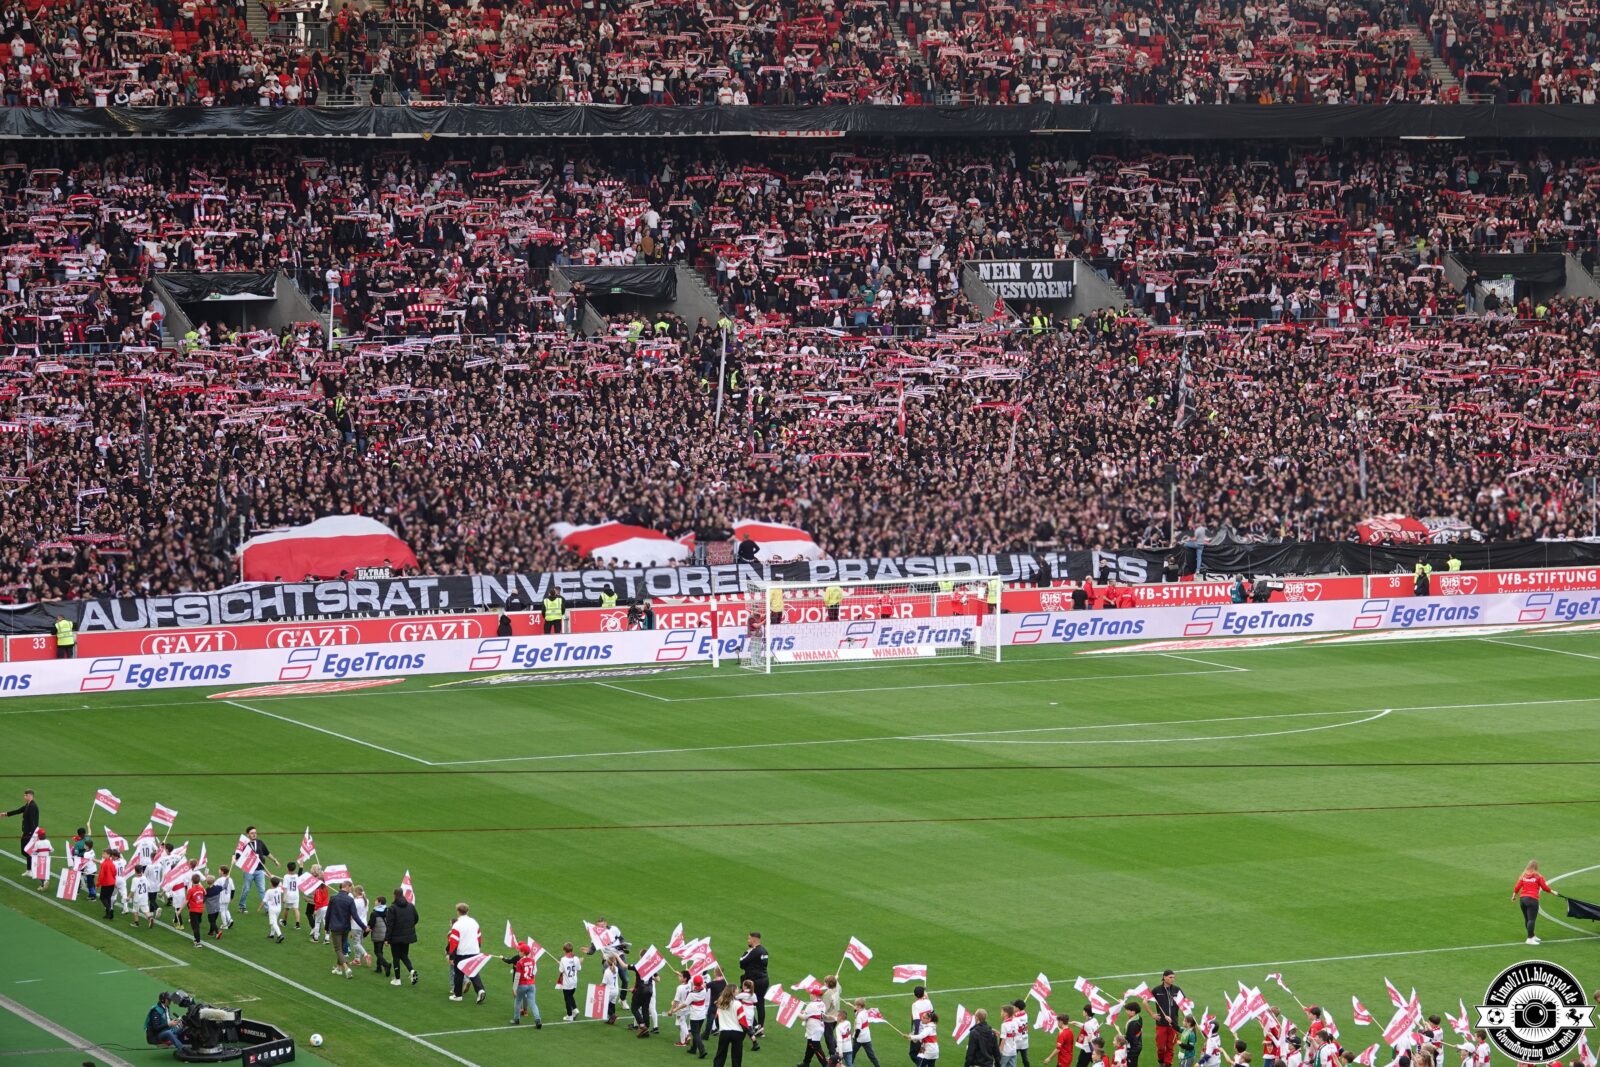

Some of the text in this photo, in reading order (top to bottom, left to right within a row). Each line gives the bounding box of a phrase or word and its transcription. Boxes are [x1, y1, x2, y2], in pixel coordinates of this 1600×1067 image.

[979, 262, 1054, 280] NEIN ZU
[987, 281, 1073, 299] VESTOREN!
[1389, 576, 1401, 588] 36
[1497, 570, 1597, 586] VfB-STIFTUNG
[79, 579, 449, 631] AUFSICHTSRAT,
[1092, 551, 1148, 583] ES
[528, 614, 541, 626] 34
[1222, 611, 1315, 634] EgeTrans
[1391, 603, 1480, 627] EgeTrans
[878, 626, 972, 647] EgeTrans
[1052, 617, 1145, 642] EgeTrans
[33, 637, 46, 650] 33
[872, 647, 919, 658] WINAMAX
[512, 642, 613, 667] EgeTrans
[792, 650, 839, 661] WINAMAX
[322, 651, 426, 677] EgeTrans
[125, 661, 232, 688] EgeTrans
[137, 883, 147, 895] 23
[566, 965, 576, 978] 25
